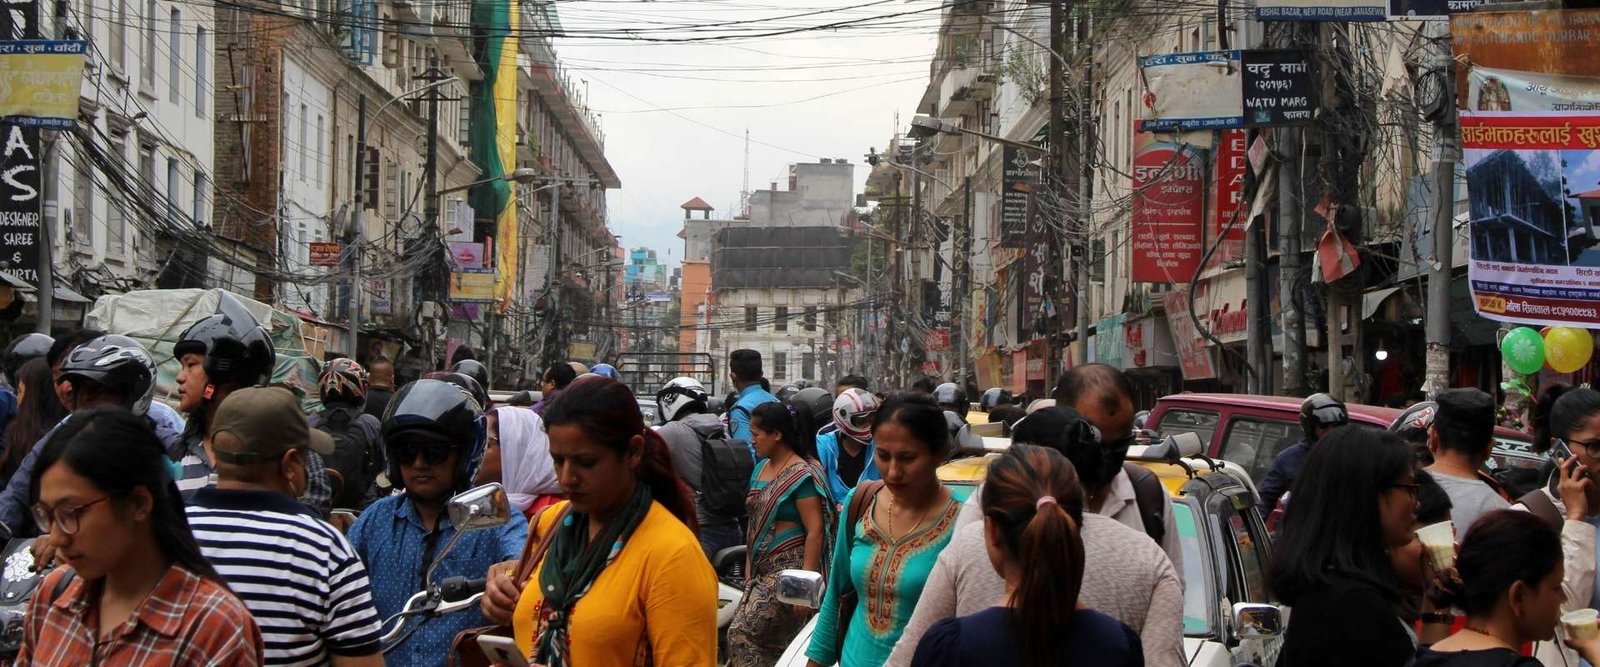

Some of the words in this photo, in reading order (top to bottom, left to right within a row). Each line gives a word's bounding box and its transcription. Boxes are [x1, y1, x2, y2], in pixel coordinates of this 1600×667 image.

[1303, 7, 1317, 16] NEW
[1317, 7, 1333, 16] ROAD
[1246, 96, 1277, 110] WATU
[1280, 96, 1308, 108] MARG
[0, 211, 39, 228] DESIGNER
[3, 232, 34, 246] SAREE
[12, 251, 22, 264] &
[4, 268, 39, 283] URTA
